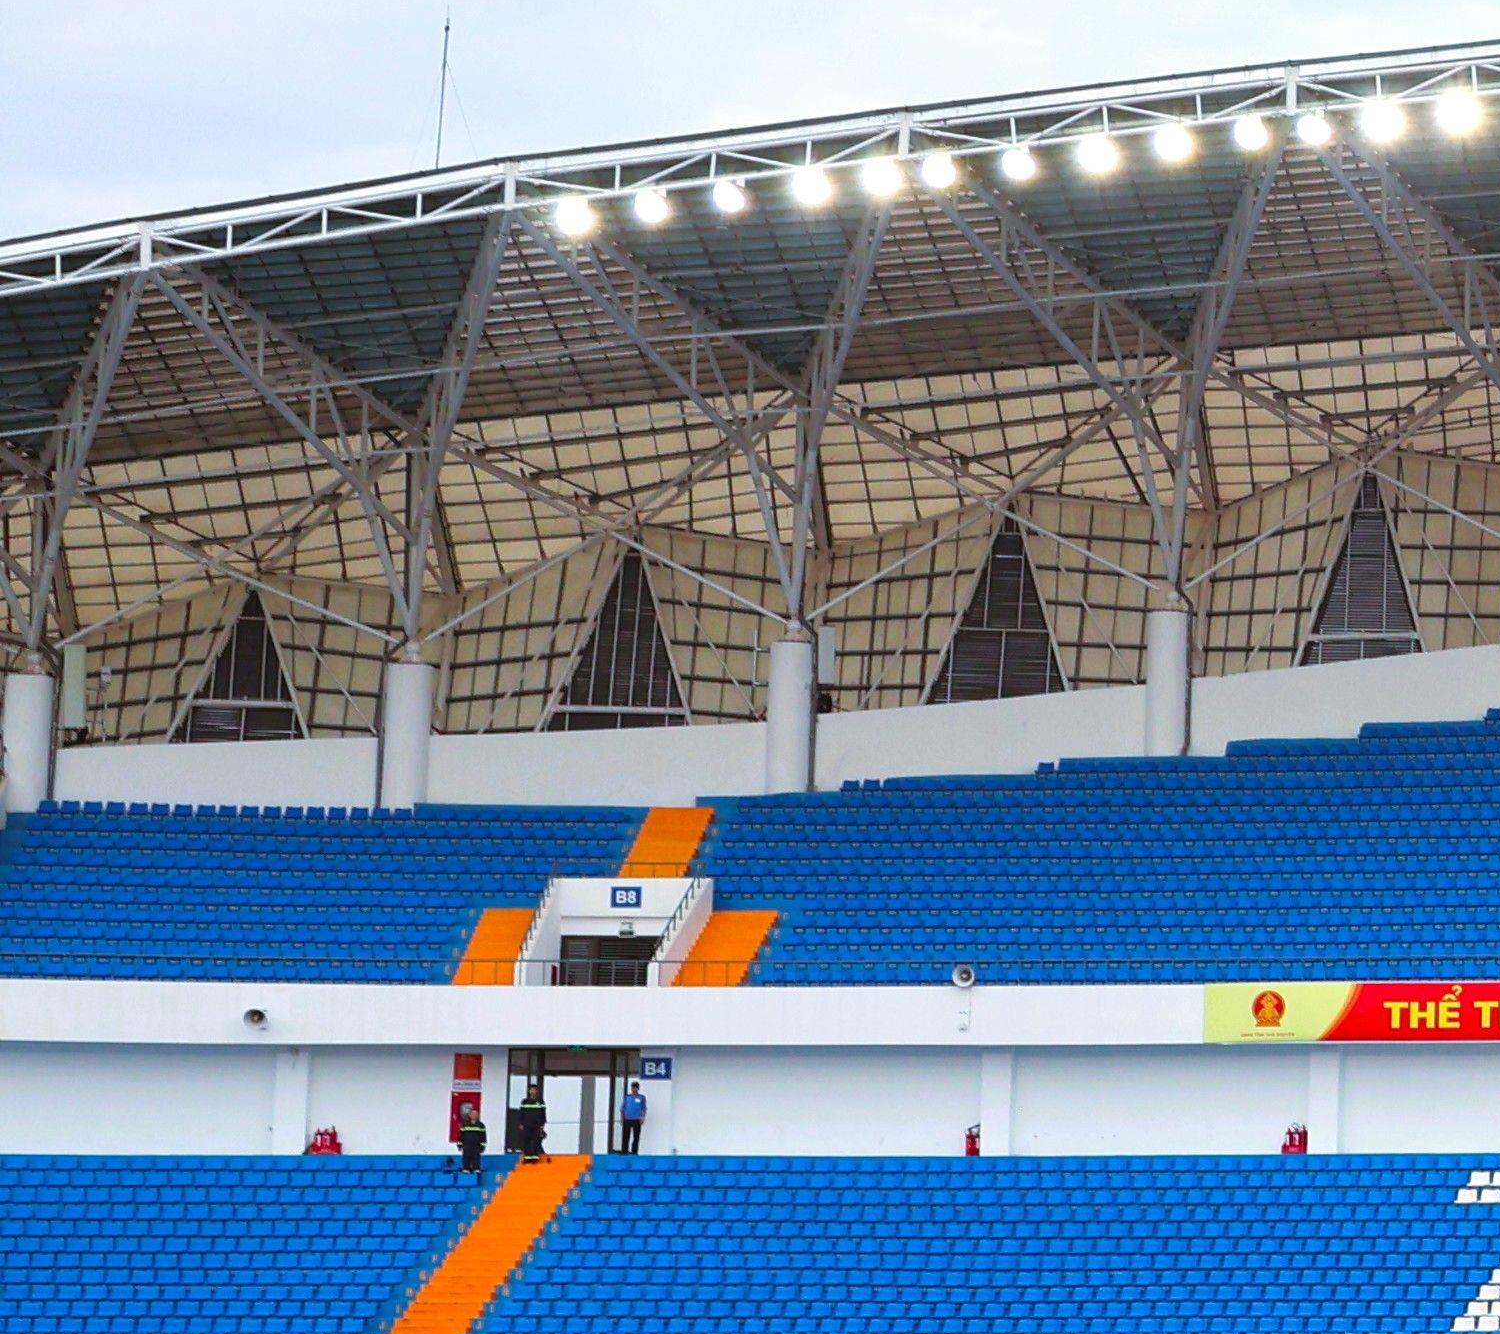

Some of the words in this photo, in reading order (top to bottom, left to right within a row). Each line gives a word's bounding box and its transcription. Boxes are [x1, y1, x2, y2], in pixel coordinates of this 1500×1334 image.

[616, 891, 636, 903] B8
[1384, 985, 1462, 1028] THỂ
[645, 1062, 666, 1075] B4
